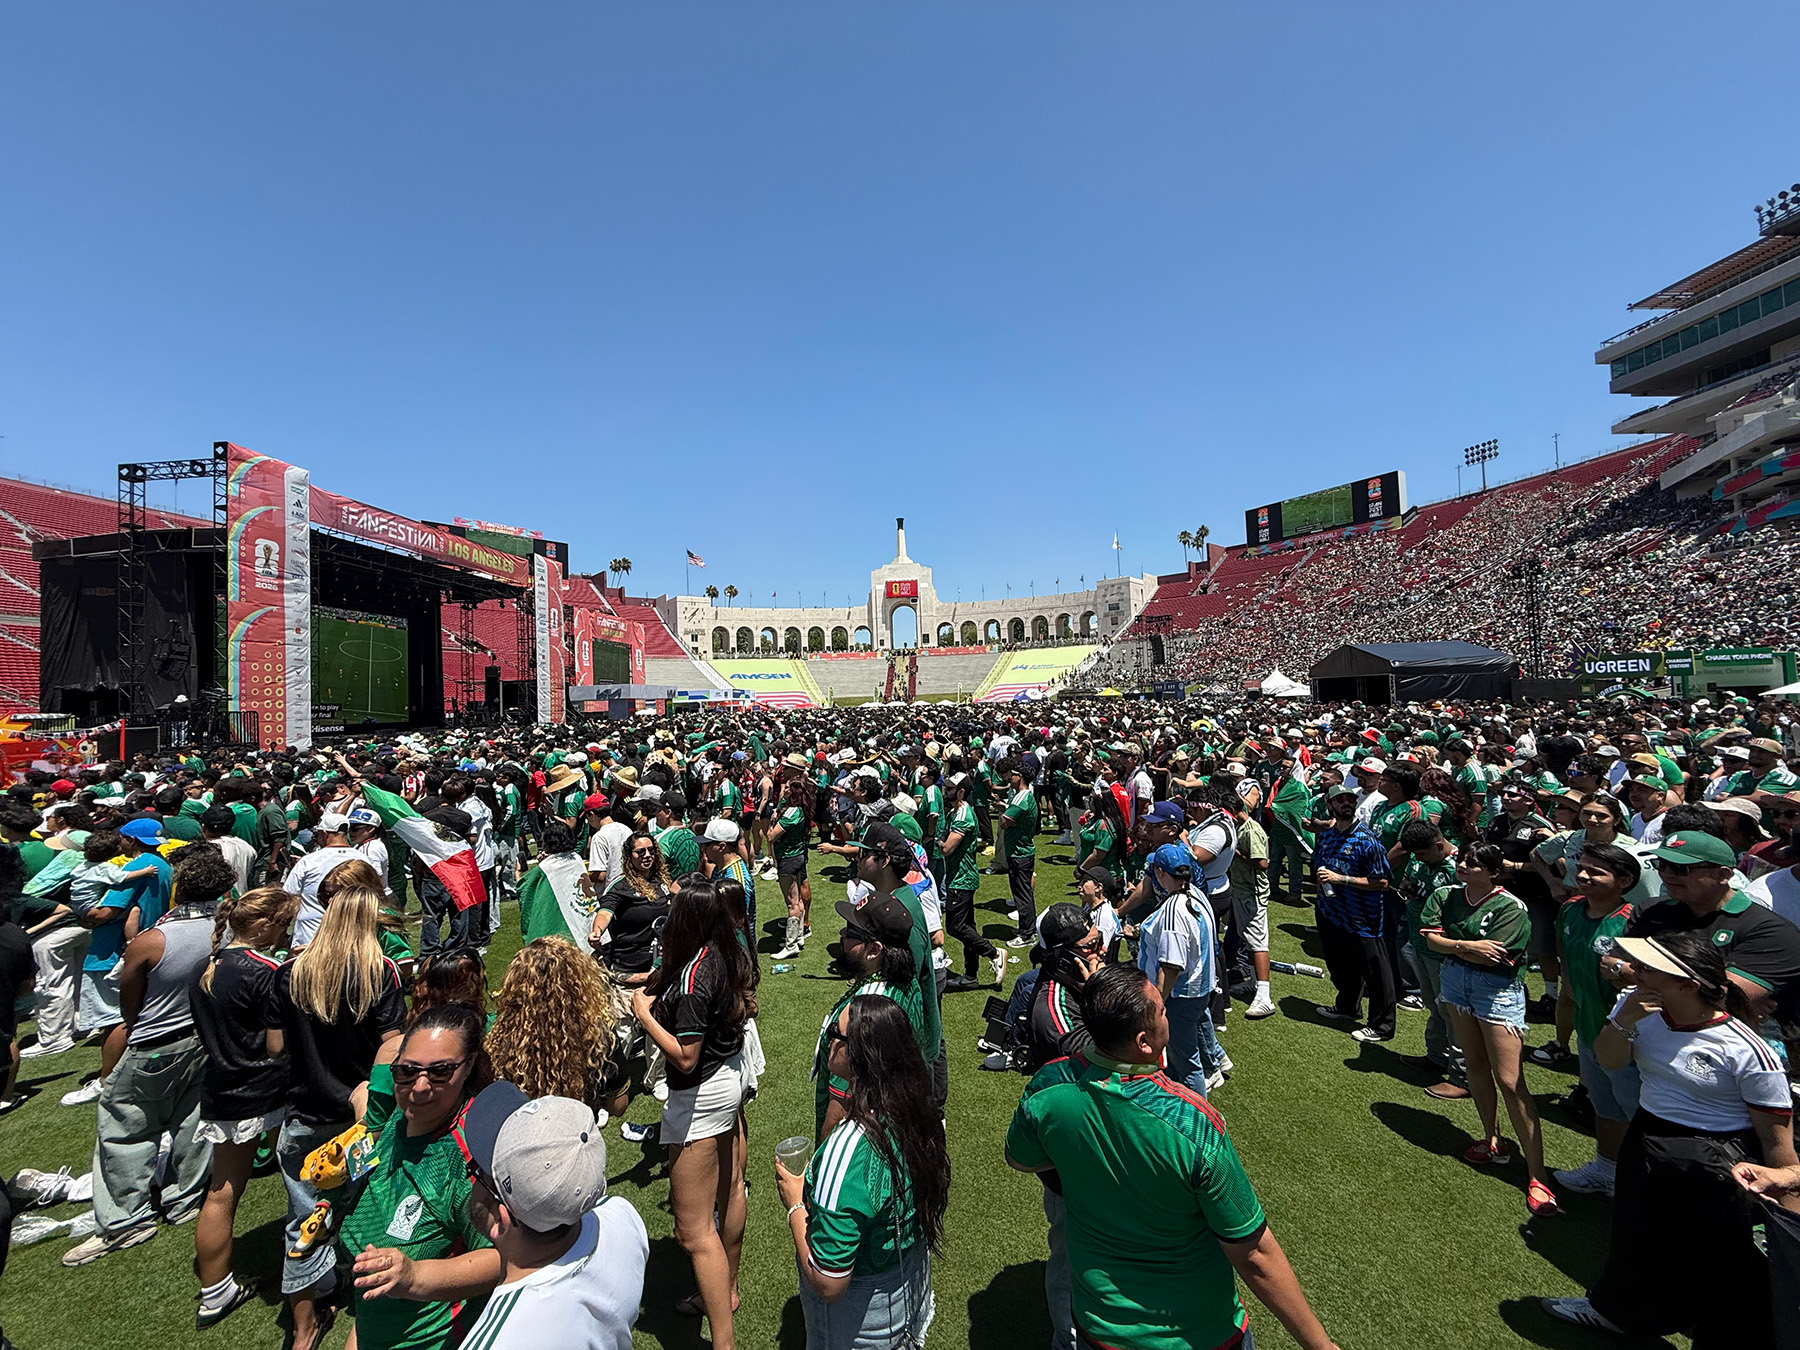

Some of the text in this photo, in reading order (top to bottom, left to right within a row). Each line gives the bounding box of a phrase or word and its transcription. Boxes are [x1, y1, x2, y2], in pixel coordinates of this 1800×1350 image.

[448, 541, 514, 574] LOS ANGELES
[255, 581, 279, 591] 2026
[1584, 659, 1651, 674] UGREEN
[1135, 869, 1145, 881] 18
